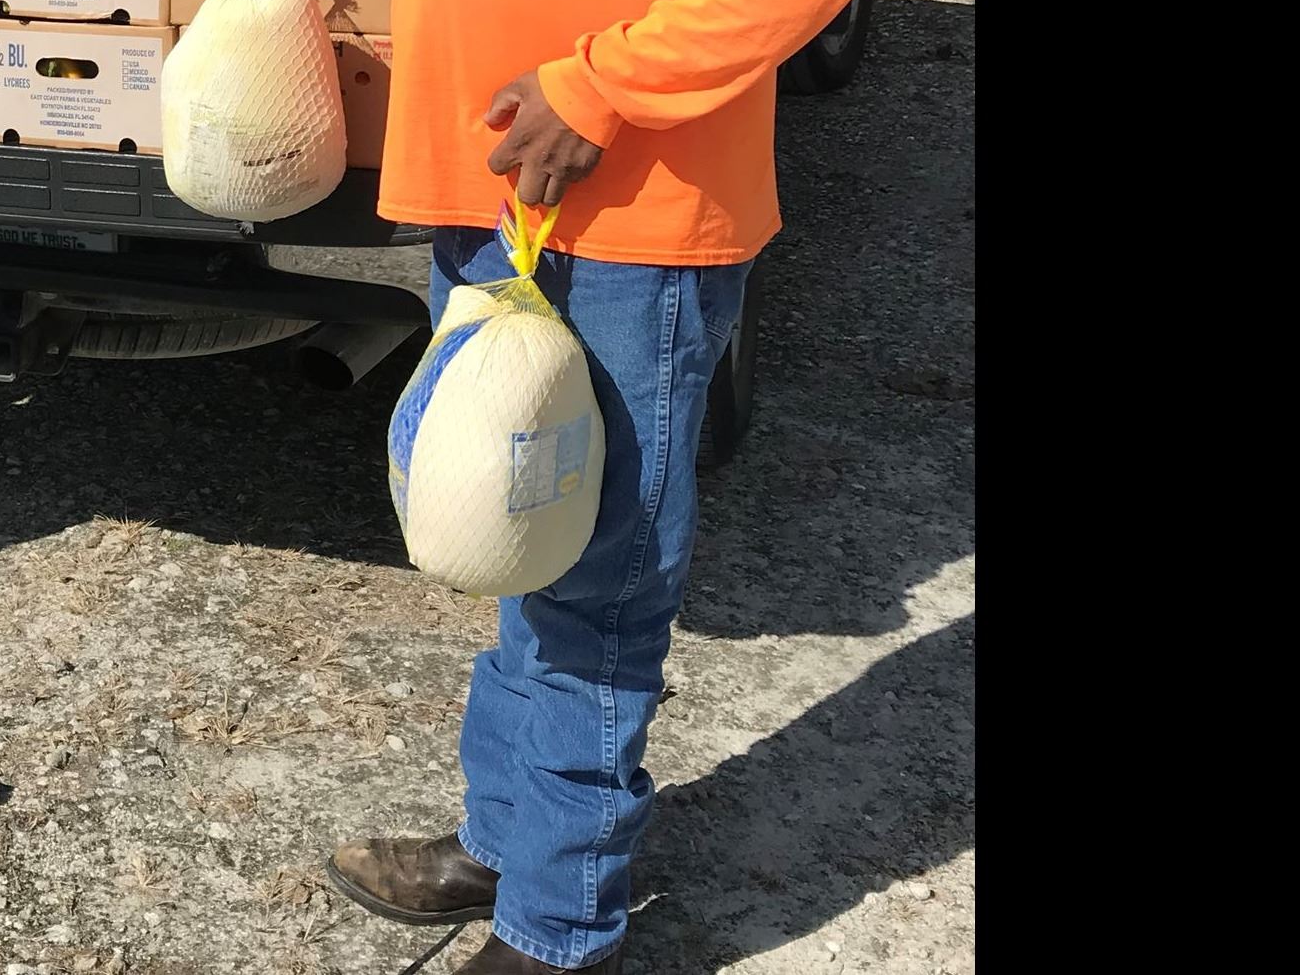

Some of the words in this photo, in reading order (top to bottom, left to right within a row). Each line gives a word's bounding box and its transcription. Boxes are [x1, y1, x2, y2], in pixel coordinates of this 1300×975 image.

[8, 43, 28, 68] BU.
[121, 48, 147, 57] PRODUCE
[129, 68, 149, 76] MEXICO
[4, 77, 31, 89] LYCHEES
[129, 76, 156, 84] HONDURAS
[129, 83, 150, 91] CANADA
[80, 97, 112, 105] VEGETABLES
[21, 231, 39, 245] WE
[41, 232, 79, 250] TRUST
